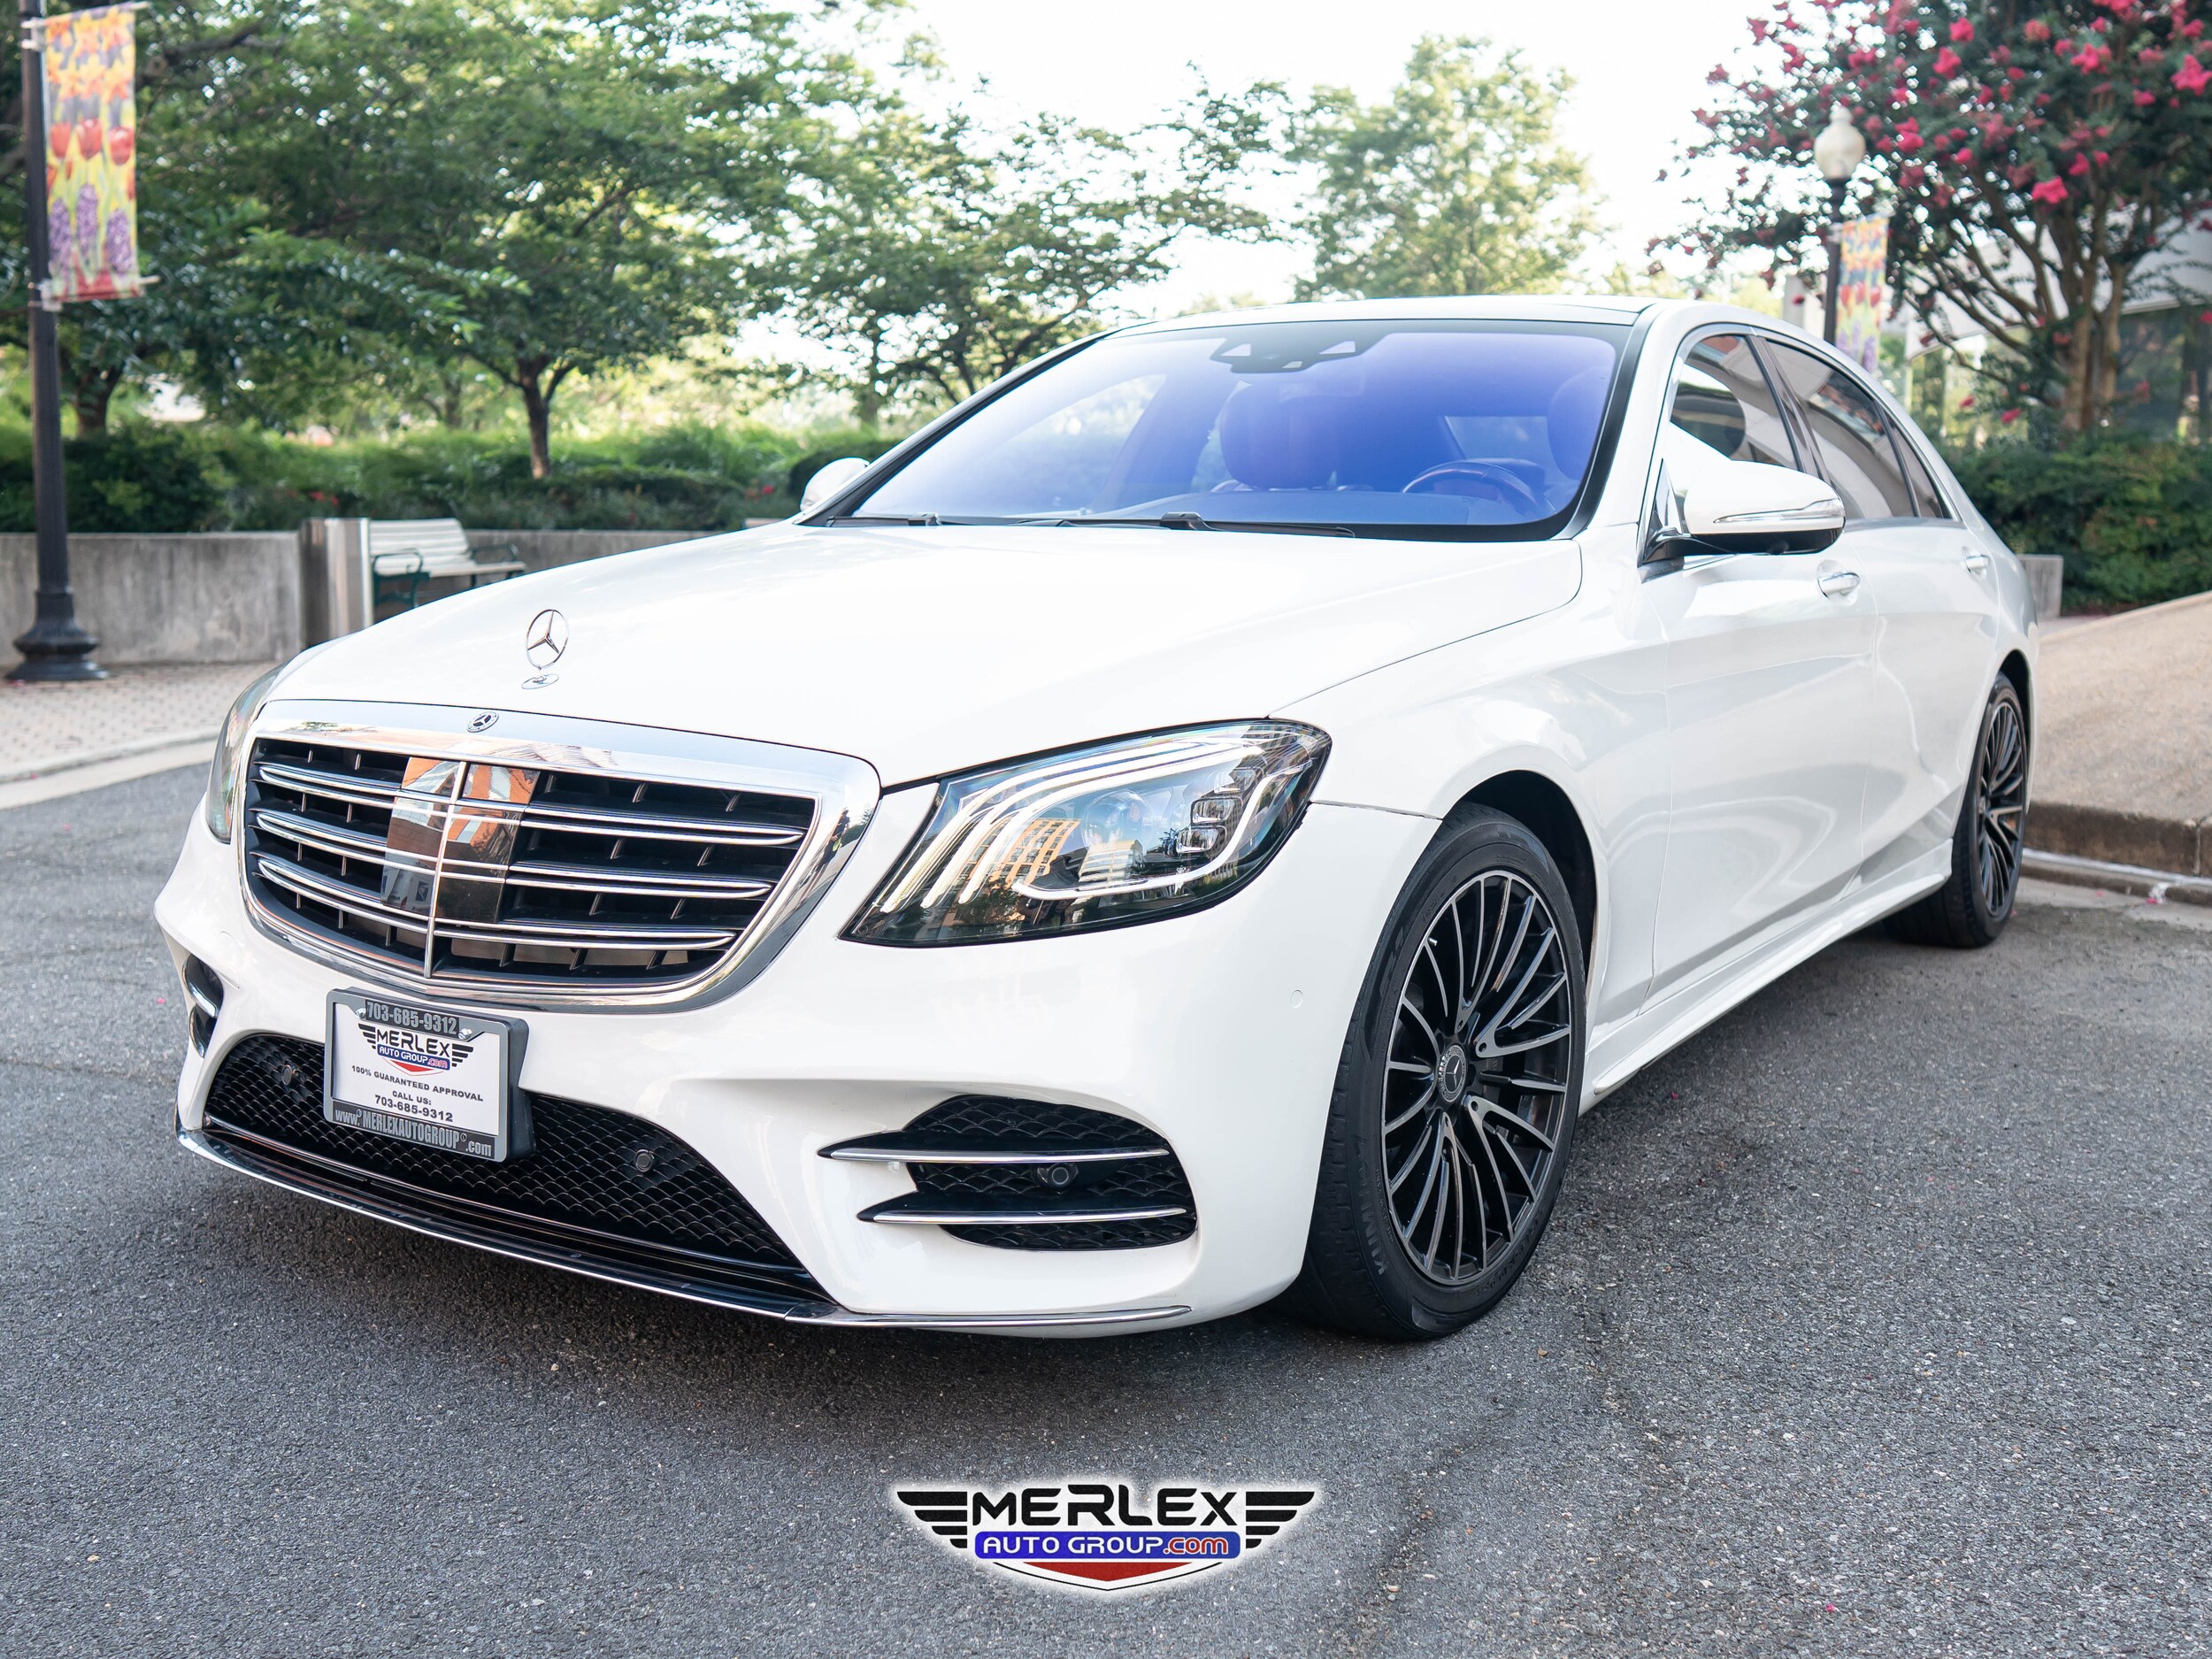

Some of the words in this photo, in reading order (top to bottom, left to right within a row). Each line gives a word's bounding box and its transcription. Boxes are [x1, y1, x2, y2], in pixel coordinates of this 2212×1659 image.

[366, 1002, 457, 1035] 703-685-9312
[376, 1029, 450, 1058] MERLEX
[379, 1045, 400, 1057] AUTO
[351, 1065, 373, 1077] 100%
[373, 1071, 429, 1091] GUARANTEED
[433, 1085, 484, 1102] APPROVAL
[392, 1090, 414, 1102] CALL
[416, 1095, 432, 1106] US:
[375, 1094, 454, 1123] 703-685-9312
